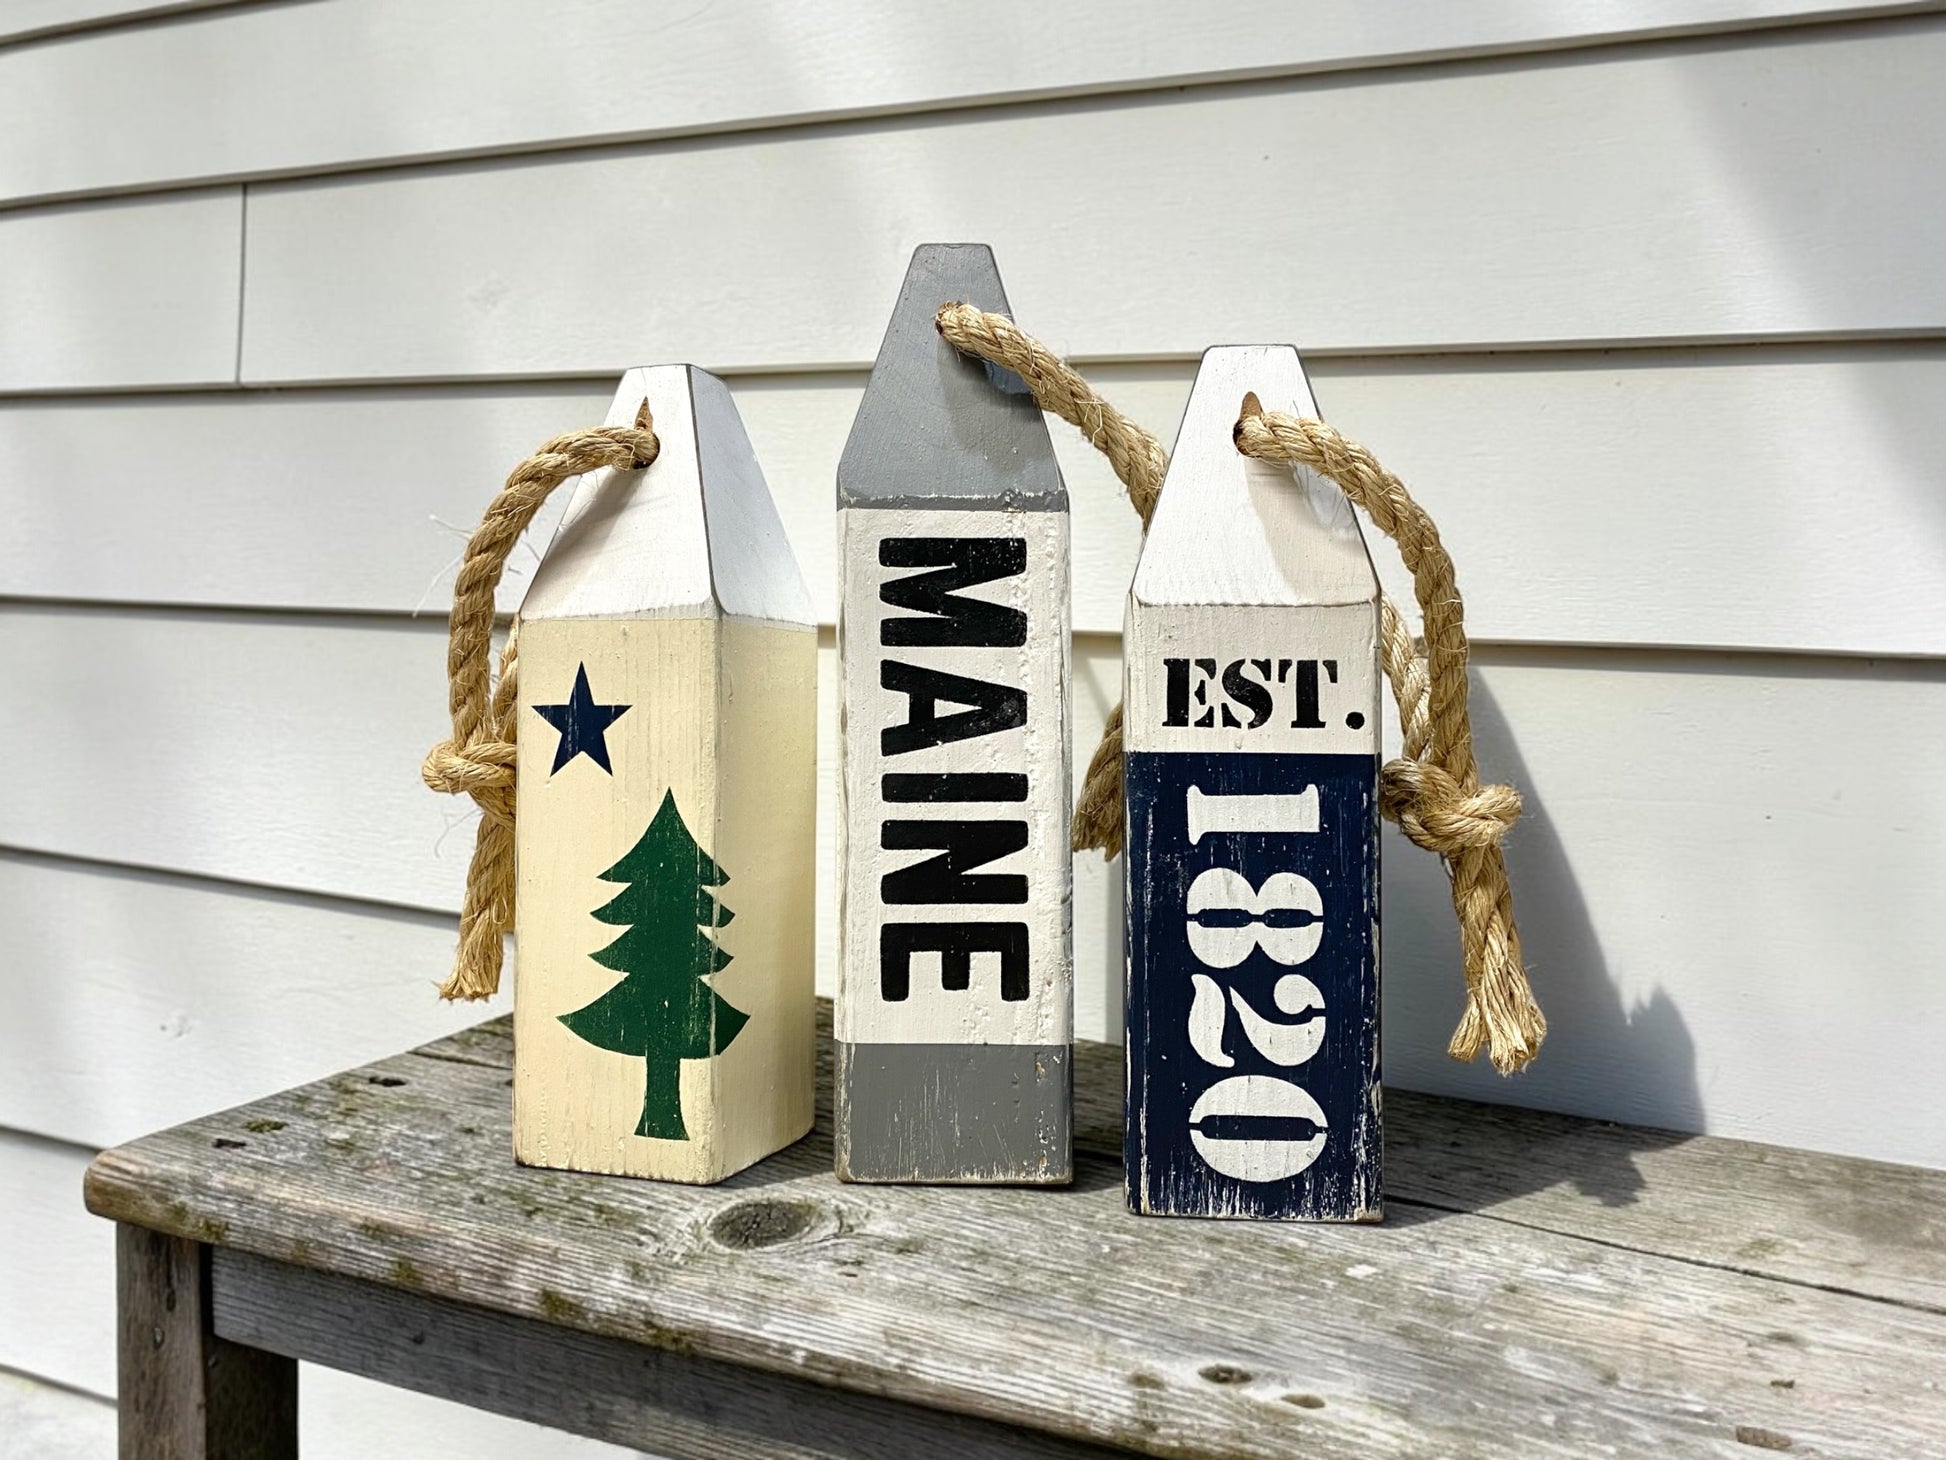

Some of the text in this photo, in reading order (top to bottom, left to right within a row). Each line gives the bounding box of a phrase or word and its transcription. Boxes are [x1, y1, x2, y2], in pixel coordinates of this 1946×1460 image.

[879, 537, 1030, 1002] MAINE
[1162, 658, 1365, 730] EST.
[1186, 783, 1329, 1183] 1820
